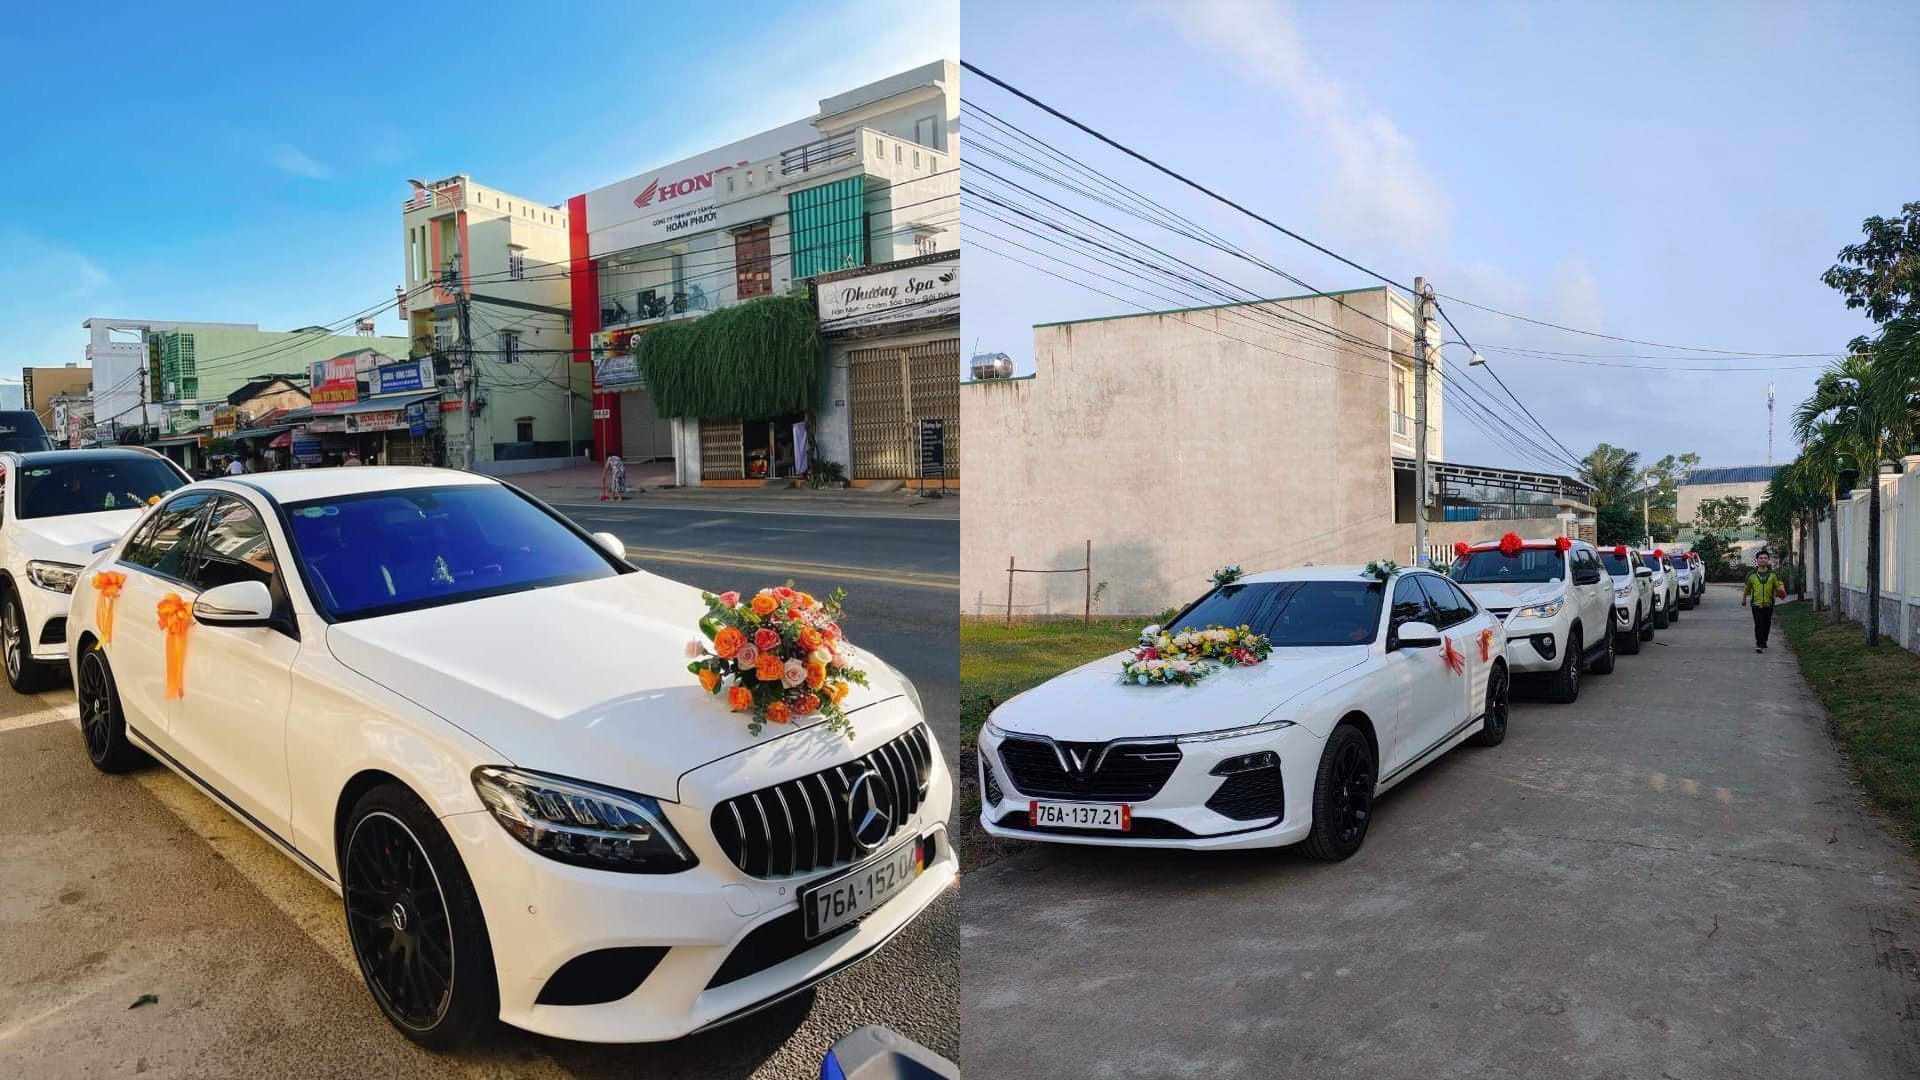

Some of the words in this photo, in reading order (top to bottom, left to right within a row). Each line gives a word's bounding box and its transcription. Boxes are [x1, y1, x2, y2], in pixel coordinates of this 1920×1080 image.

[841, 286, 899, 306] Phương
[904, 277, 935, 295] Spa
[1038, 806, 1119, 825] 76A-137.21
